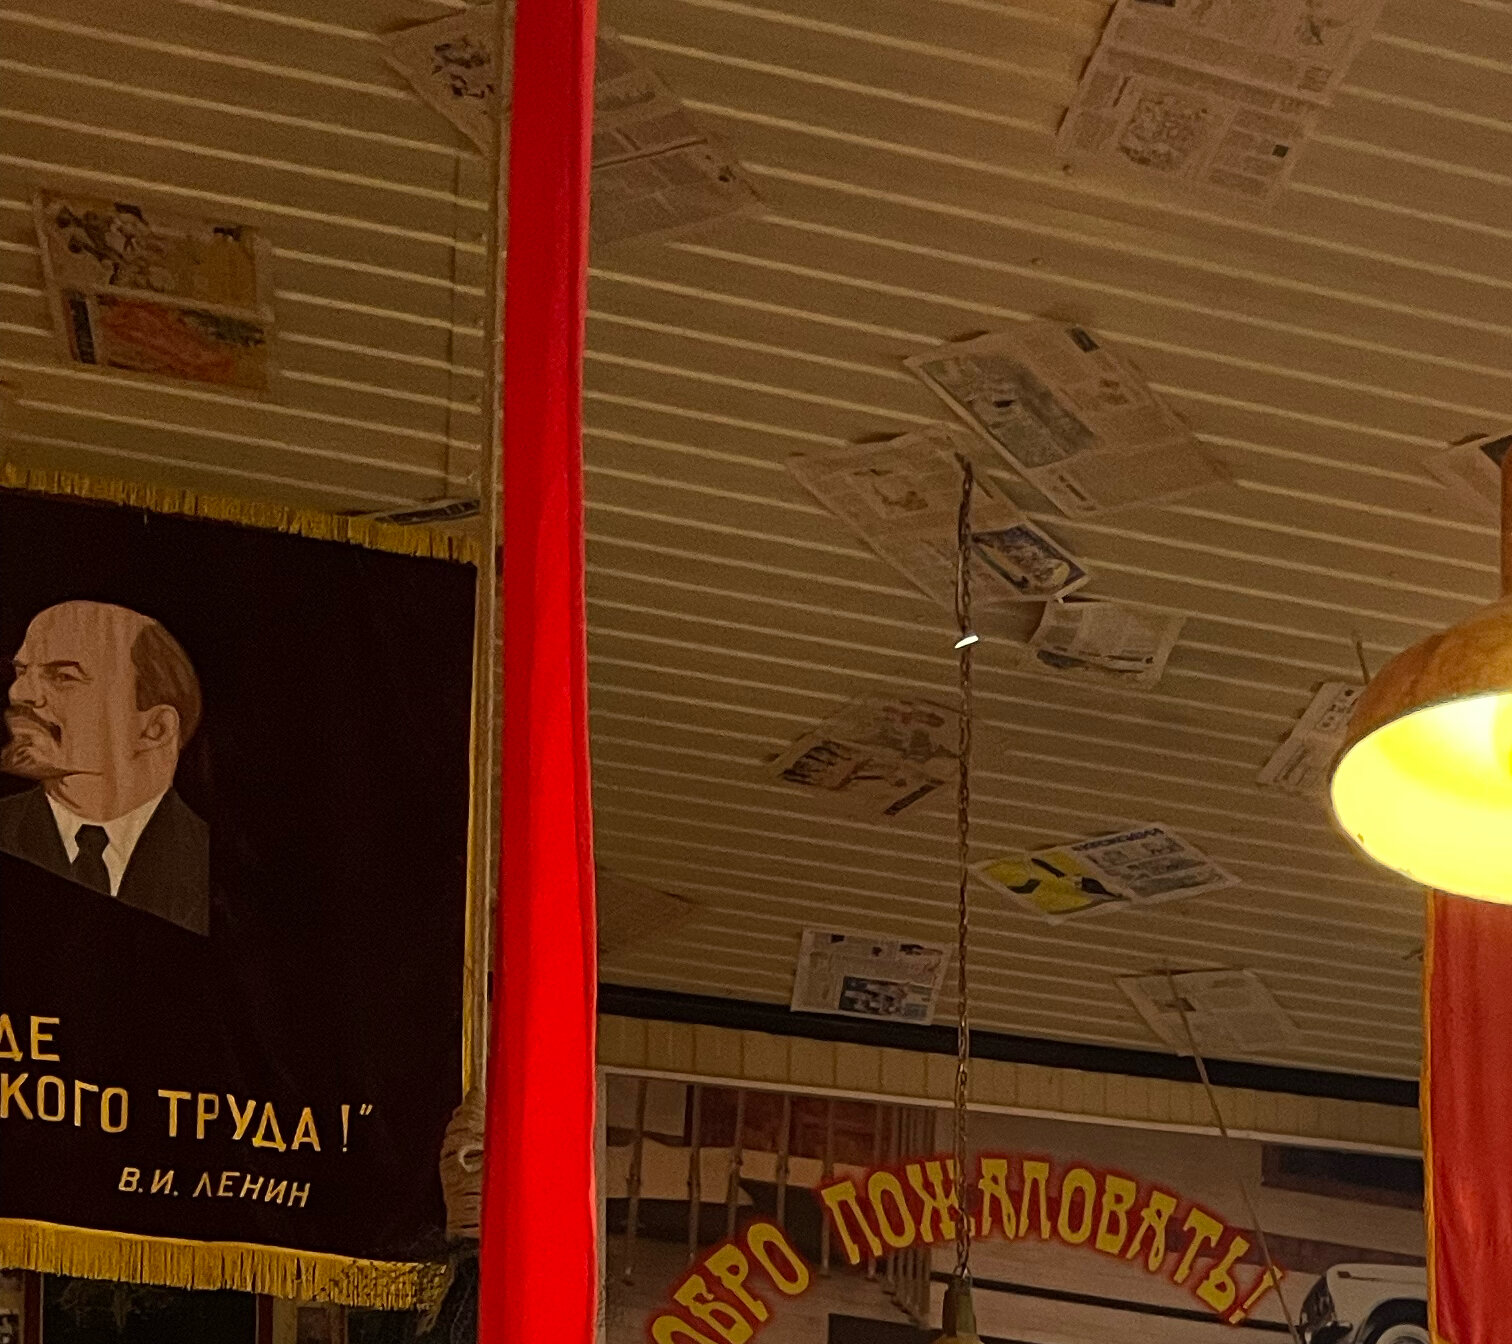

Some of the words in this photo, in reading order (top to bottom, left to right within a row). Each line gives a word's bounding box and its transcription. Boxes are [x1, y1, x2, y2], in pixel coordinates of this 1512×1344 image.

[0, 1072, 129, 1134] КОГО
[158, 1088, 321, 1152] ТРУДА
[194, 1171, 311, 1208] ЛЕНИН
